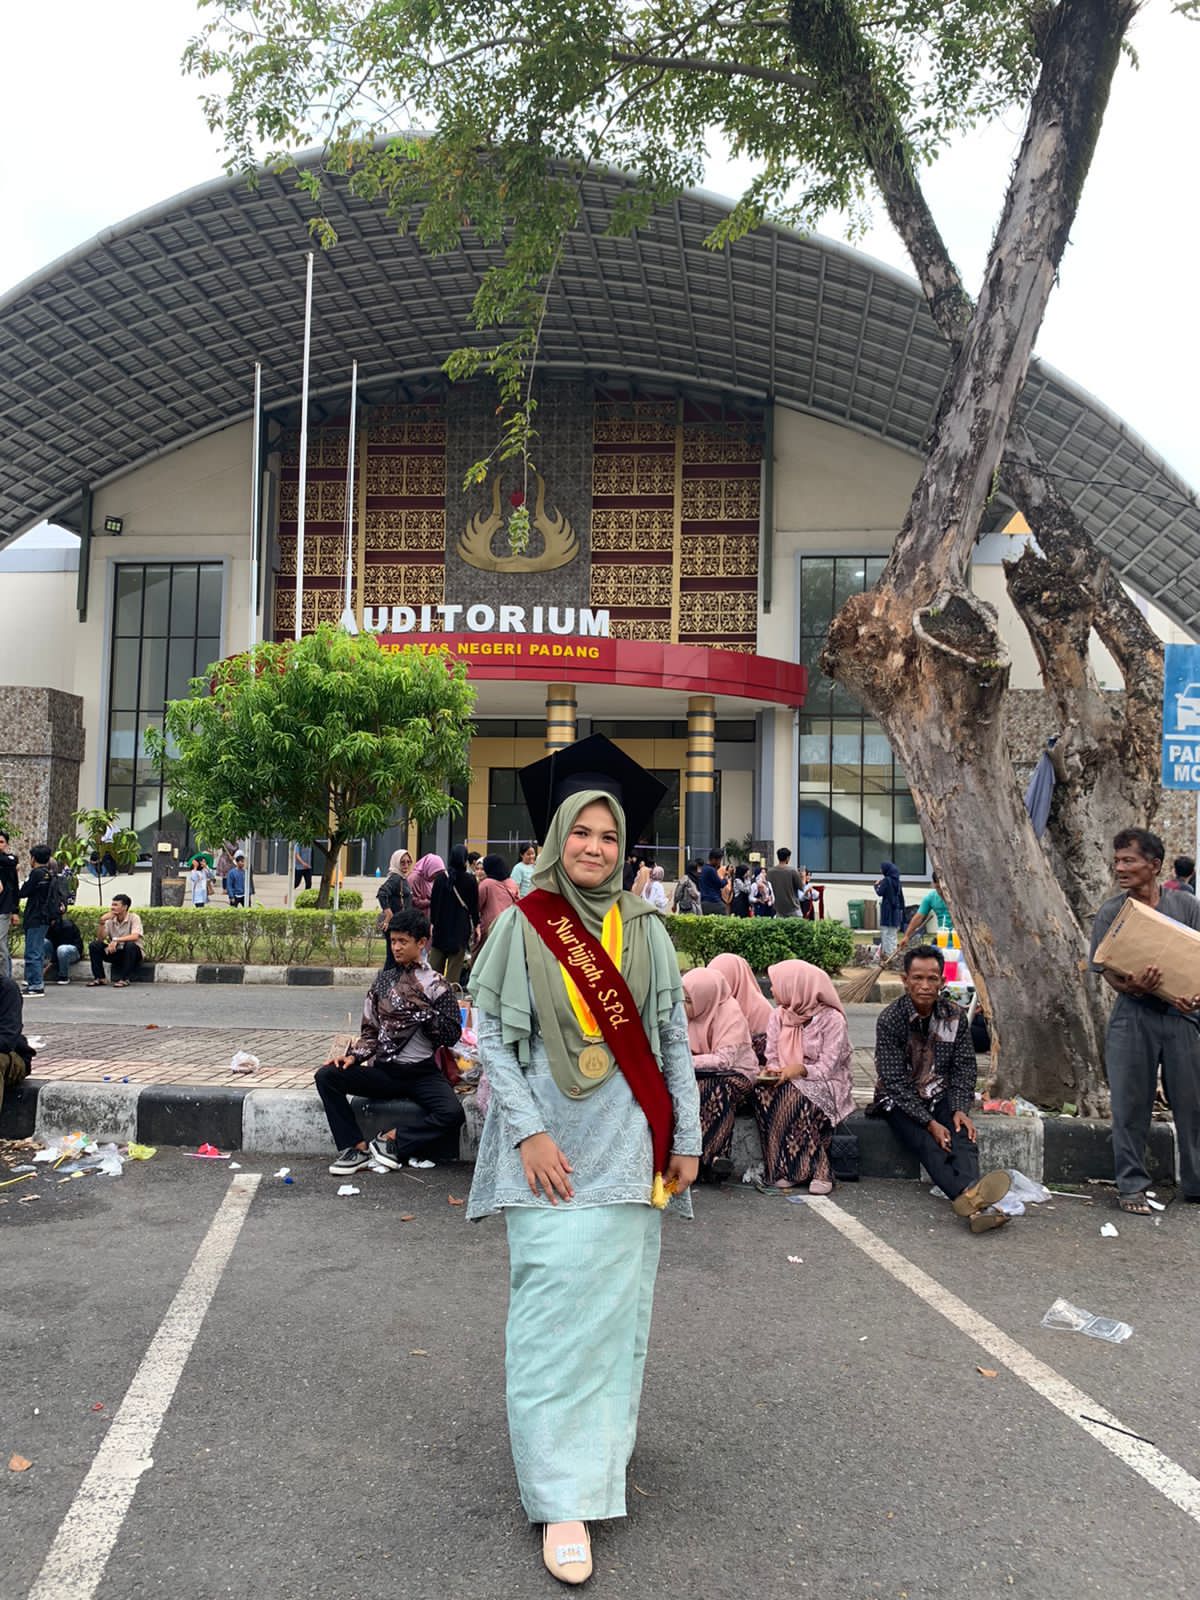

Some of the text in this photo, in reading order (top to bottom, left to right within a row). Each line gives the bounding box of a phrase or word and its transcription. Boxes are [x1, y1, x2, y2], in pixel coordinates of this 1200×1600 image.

[339, 604, 610, 637] AUDITORIUM
[457, 643, 522, 655] NEGERI
[529, 644, 600, 659] PADANG
[547, 916, 630, 1030] Nurhijjah, S.Pd.
